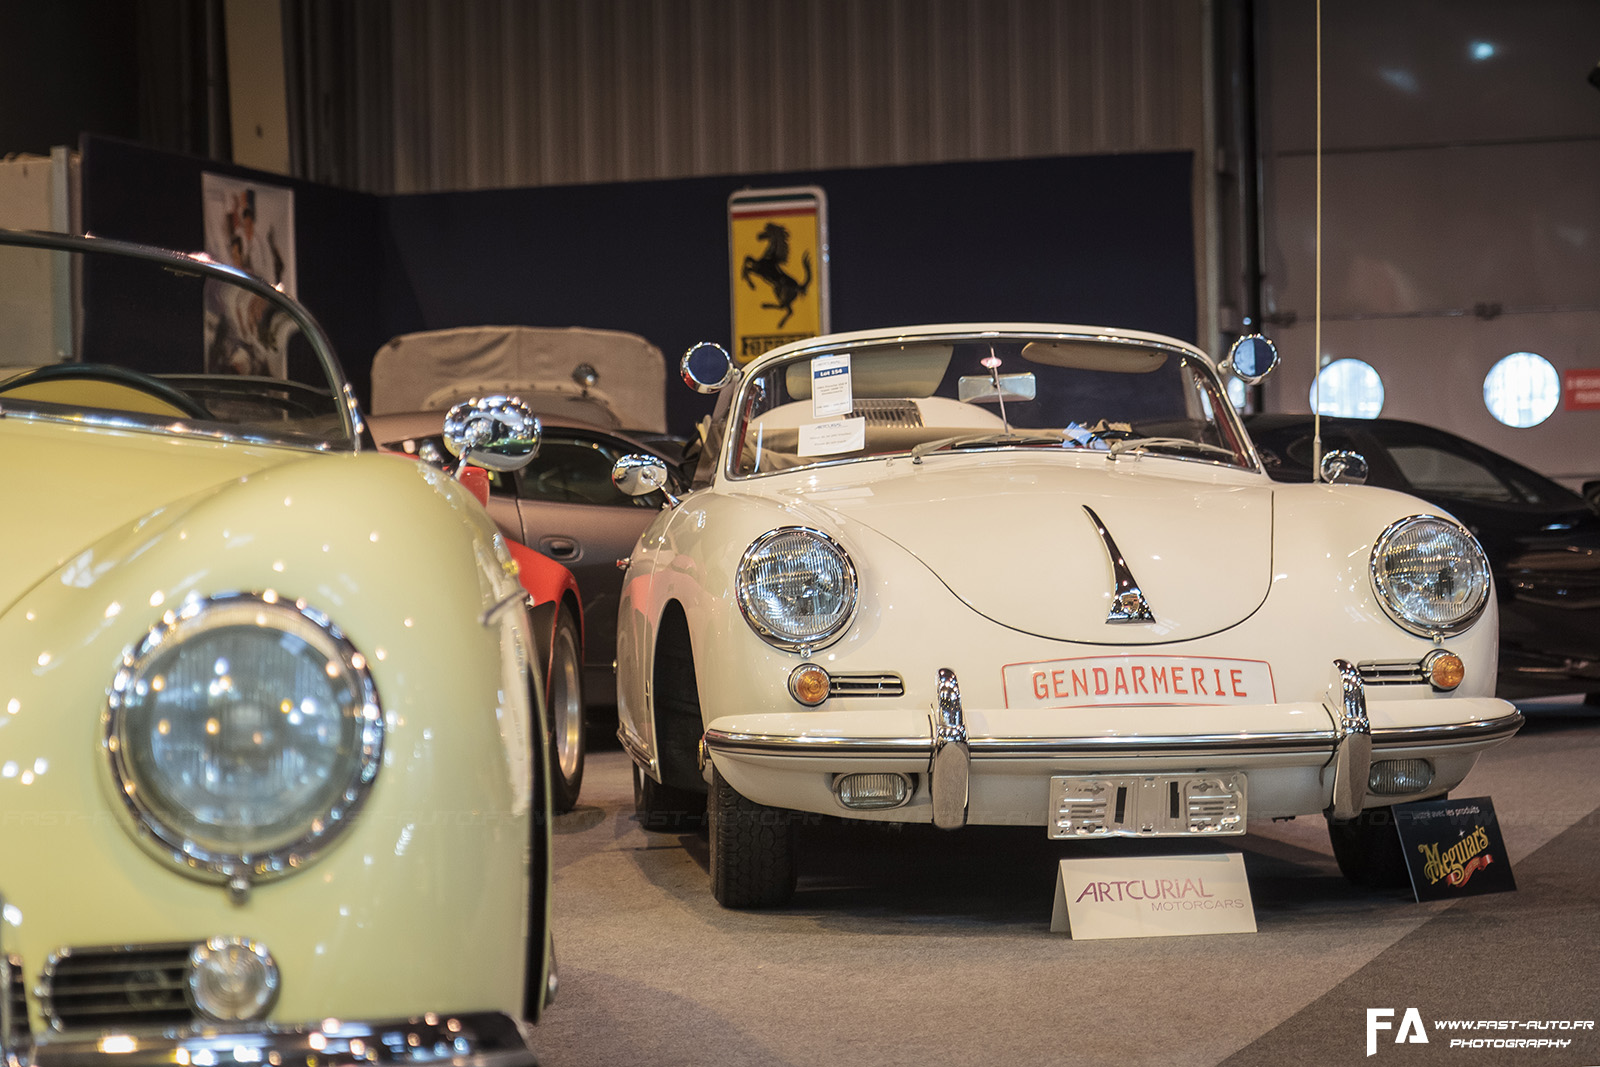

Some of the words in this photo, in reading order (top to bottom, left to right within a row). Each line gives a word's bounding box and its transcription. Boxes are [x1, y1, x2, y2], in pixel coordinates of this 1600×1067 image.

[820, 370, 831, 378] Lot
[1032, 666, 1247, 700] GENDARMERIE
[1432, 809, 1446, 818] avec
[1446, 807, 1455, 817] les
[1455, 804, 1480, 816] produits
[1417, 824, 1489, 885] Meguiar's
[1151, 899, 1245, 912] MOTORCARS
